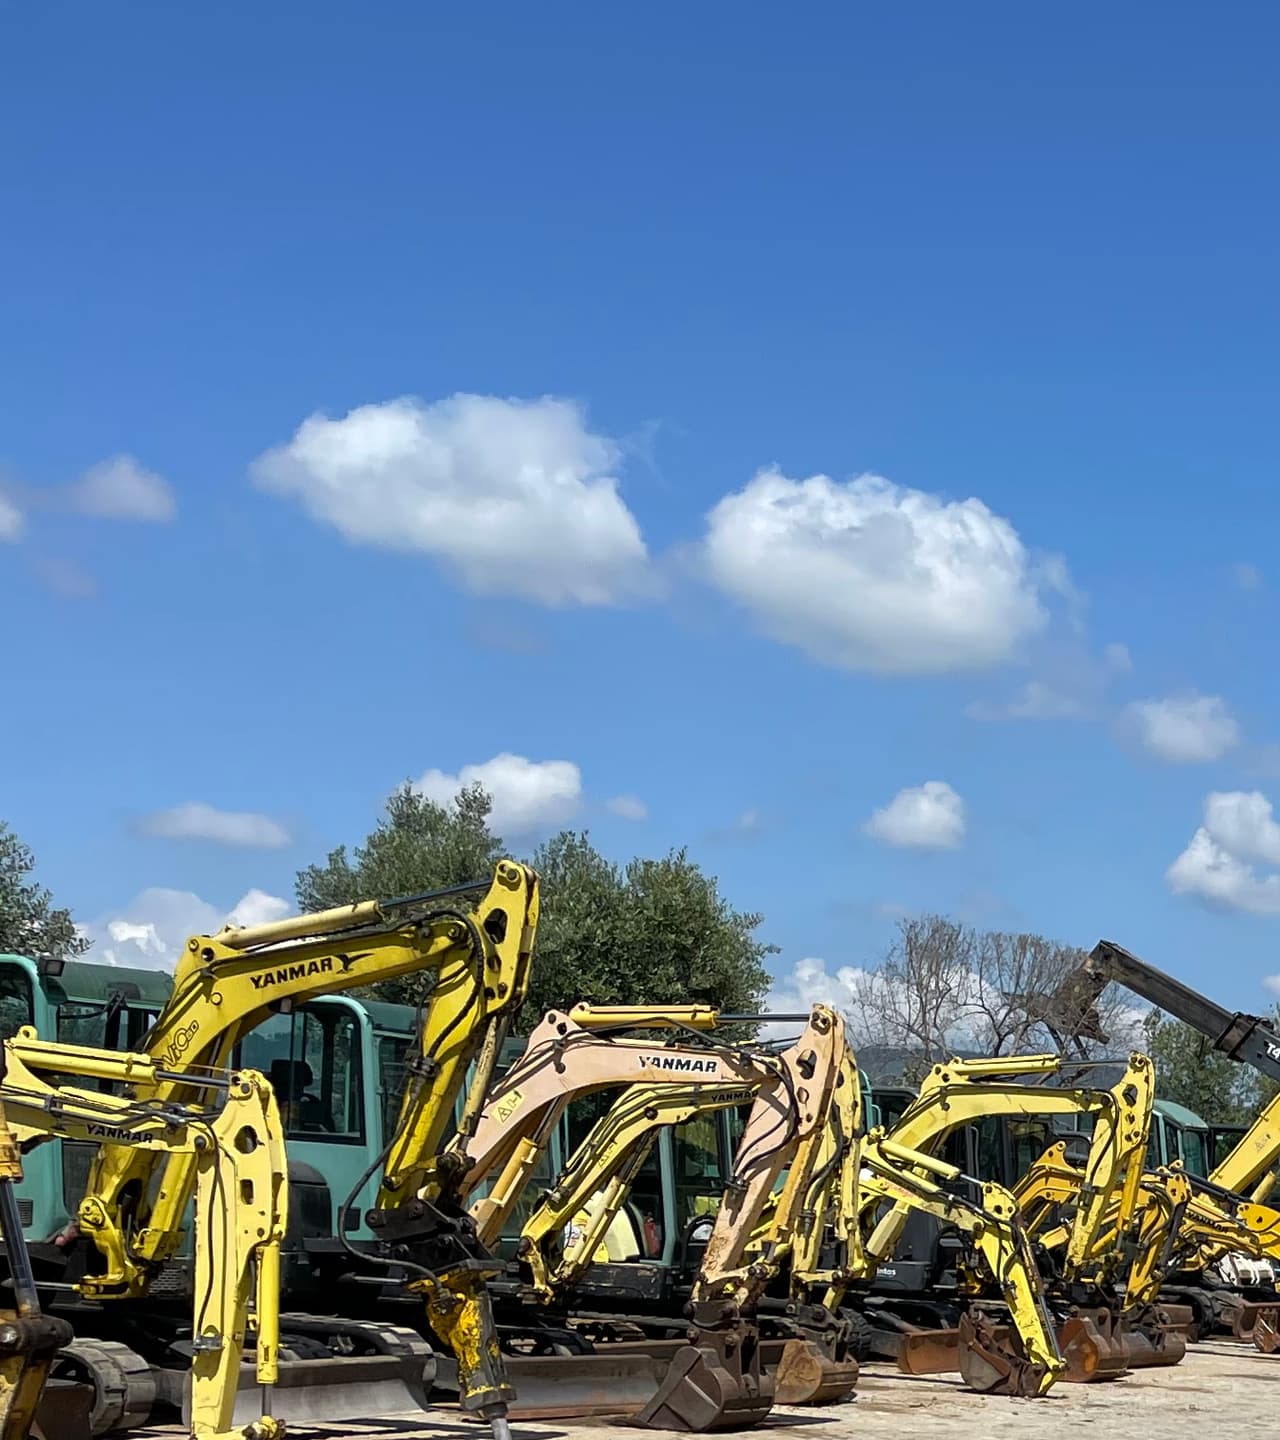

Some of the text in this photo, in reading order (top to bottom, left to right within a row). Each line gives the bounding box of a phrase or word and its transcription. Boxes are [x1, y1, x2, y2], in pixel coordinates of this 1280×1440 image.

[250, 957, 333, 990] YANMAR
[638, 1055, 718, 1073] YANMAR
[86, 1122, 154, 1144] YANMAR
